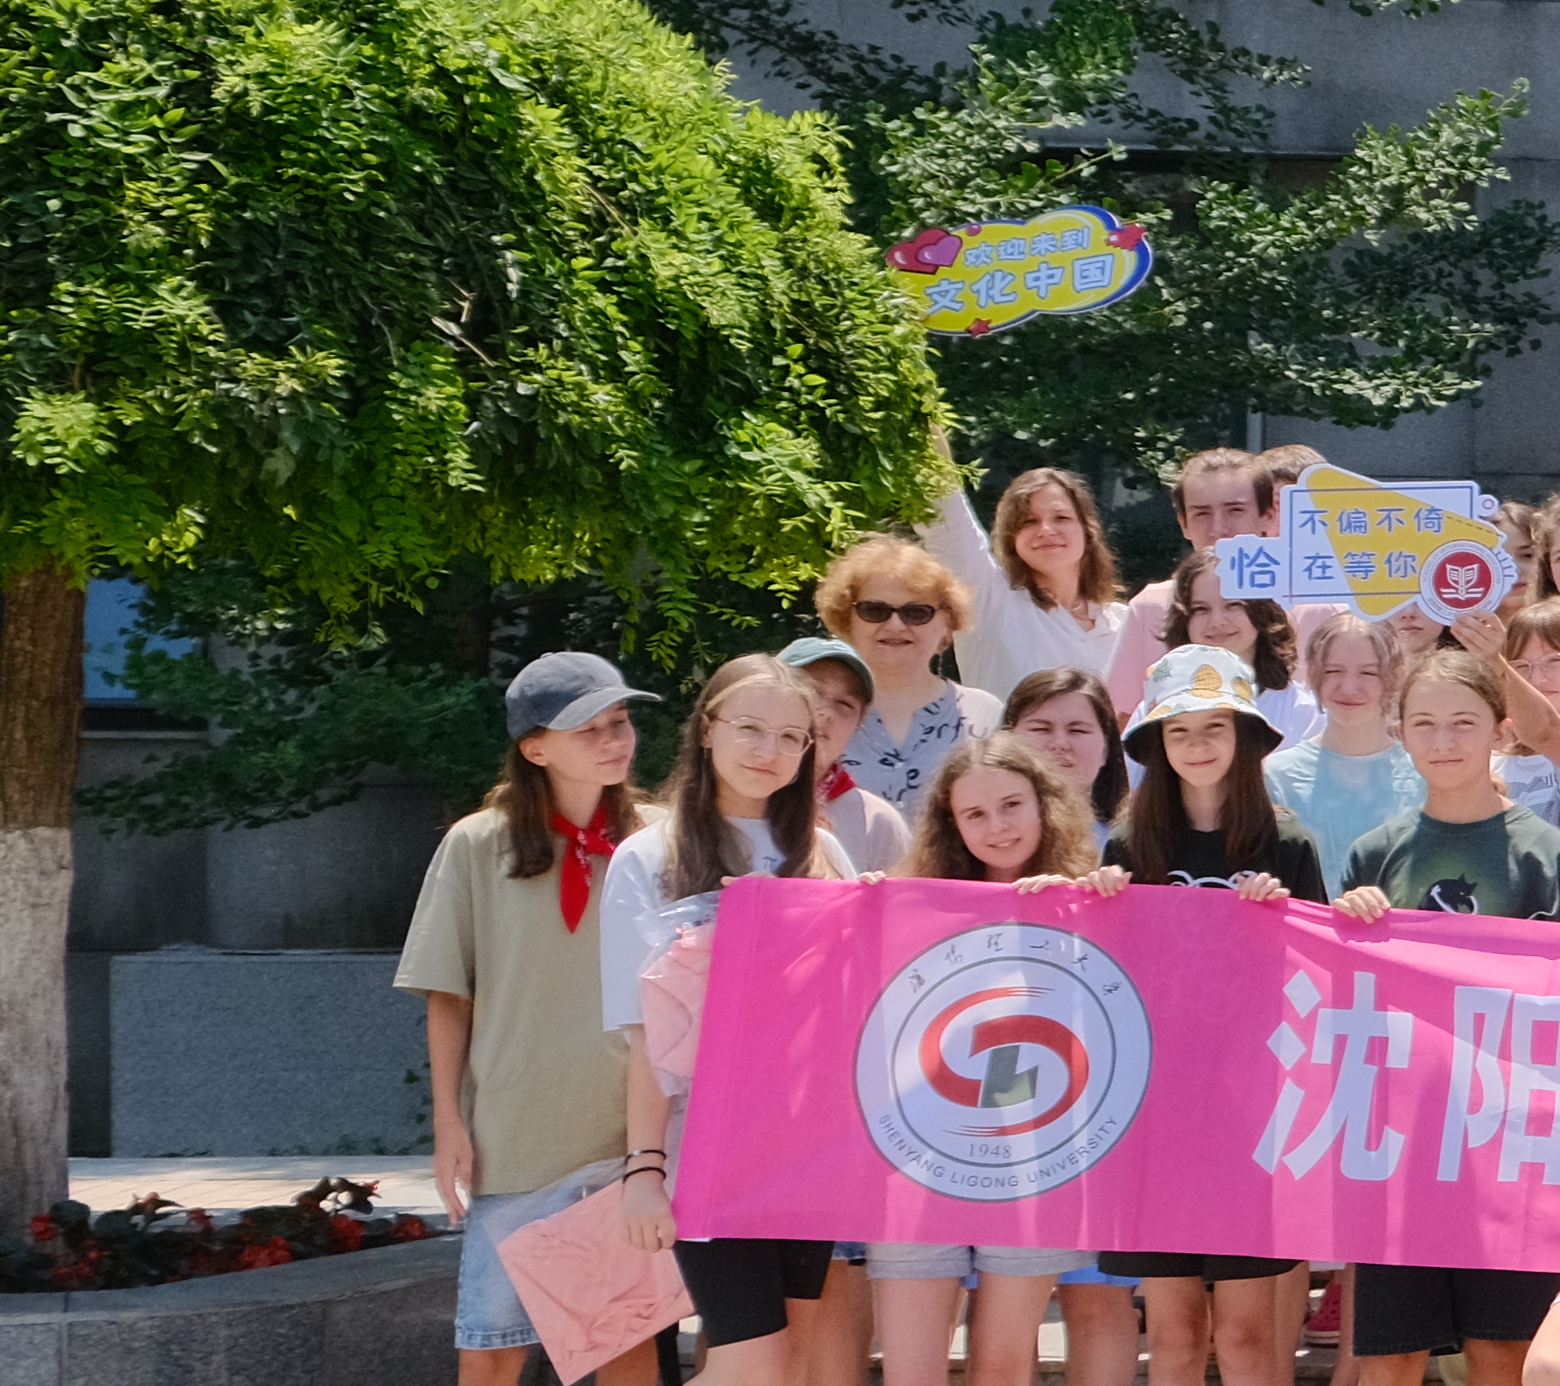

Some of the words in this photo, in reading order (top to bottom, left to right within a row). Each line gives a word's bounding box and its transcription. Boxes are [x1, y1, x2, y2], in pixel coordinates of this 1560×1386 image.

[964, 225, 1091, 268] 欢迎来到
[924, 253, 1116, 313] 文化中国
[1299, 507, 1445, 535] 不偏不倚
[1229, 545, 1281, 589] 恰
[1302, 550, 1420, 582] 在等你
[878, 1113, 945, 1179] SHENYANG
[949, 1171, 1019, 1189] LIGONG
[1026, 1115, 1119, 1184] UNIVERSITY
[967, 1143, 1013, 1160] 1948
